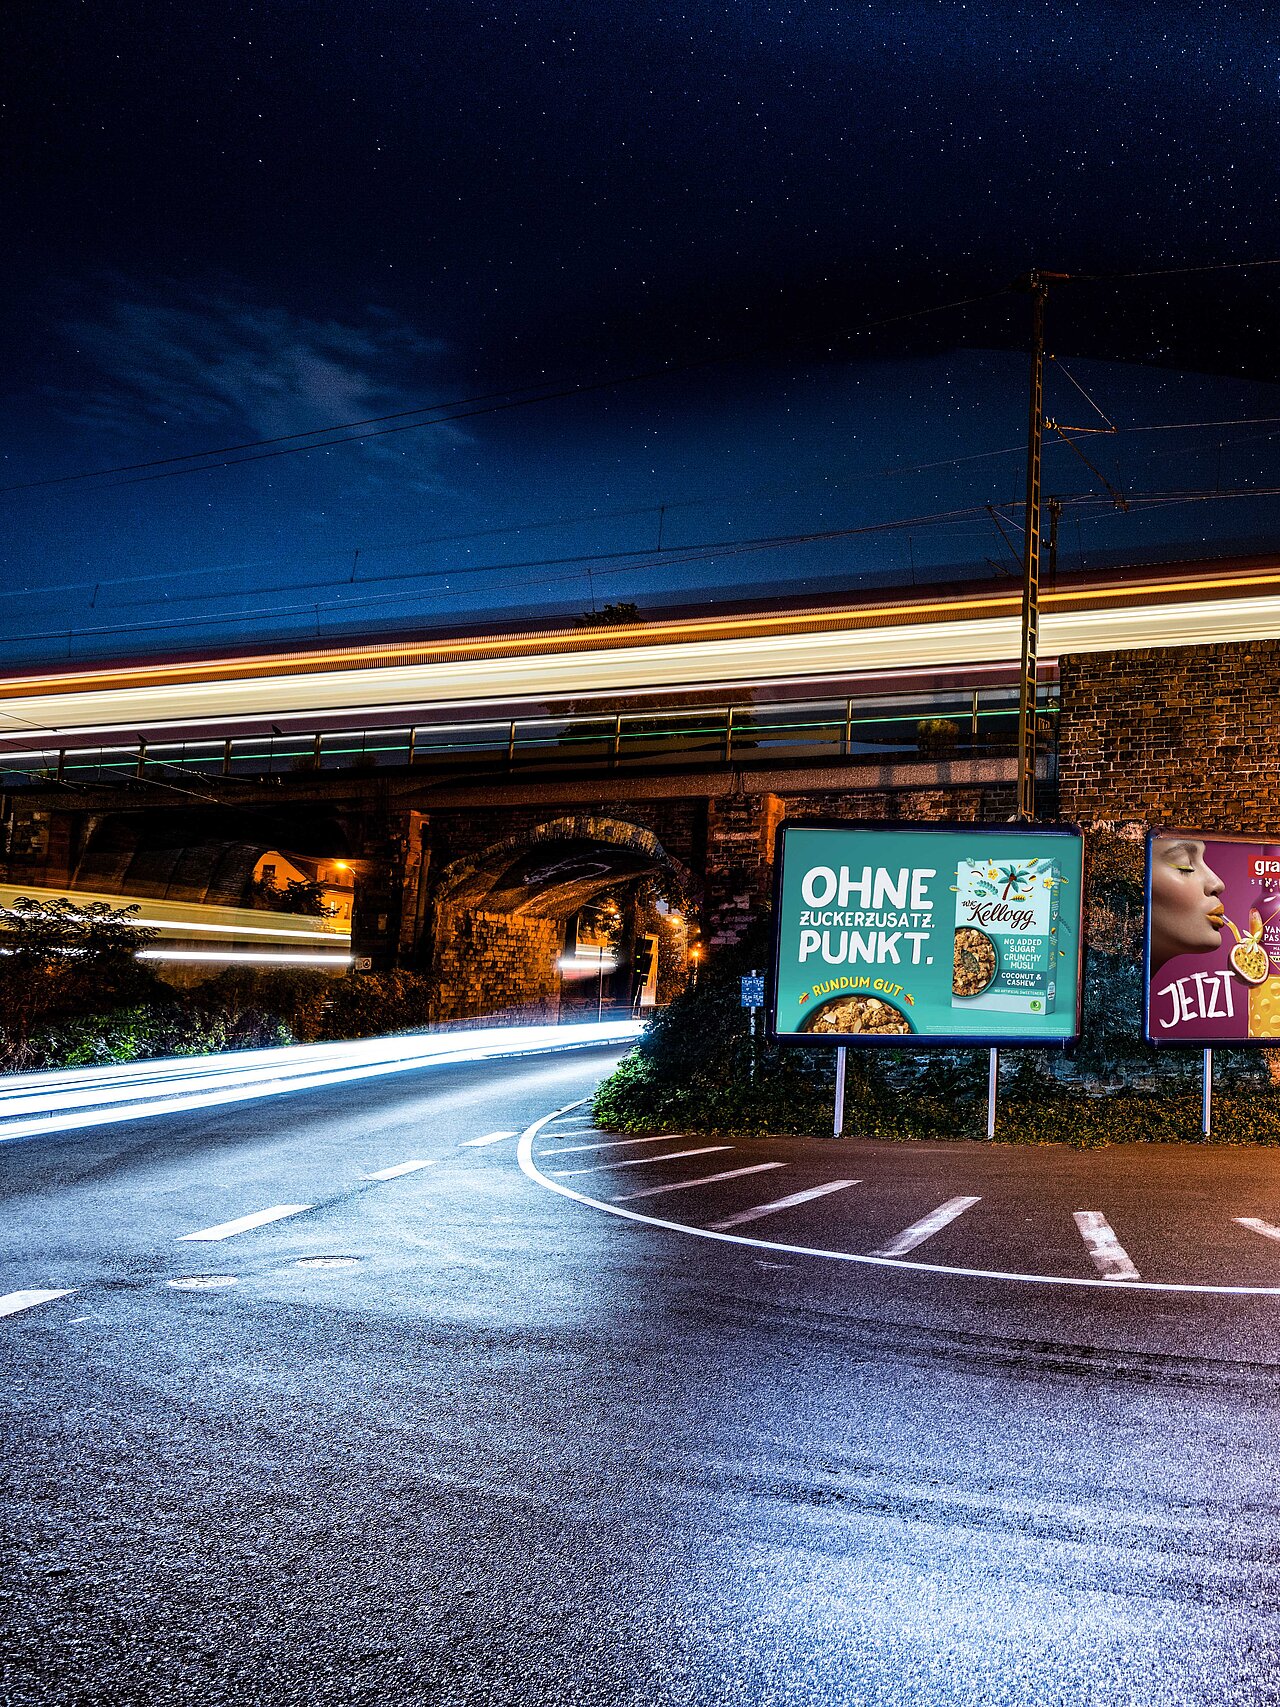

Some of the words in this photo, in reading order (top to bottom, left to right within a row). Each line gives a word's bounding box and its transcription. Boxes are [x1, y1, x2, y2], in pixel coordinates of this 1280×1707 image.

[801, 866, 937, 910] OHNE
[799, 911, 936, 929] ZUCKERZUSATZ.
[967, 902, 1037, 931] Kellogg
[798, 930, 934, 965] PUNKT.
[1009, 945, 1036, 953] SUGAR
[1017, 938, 1042, 946] ADDED
[1003, 953, 1042, 962] CRUNCHY
[1001, 972, 1035, 980] COCONUT
[1006, 979, 1036, 987] CASHEW
[811, 976, 871, 997] RUNDUM
[873, 978, 904, 997] GUT
[1157, 970, 1237, 1029] JETZT
